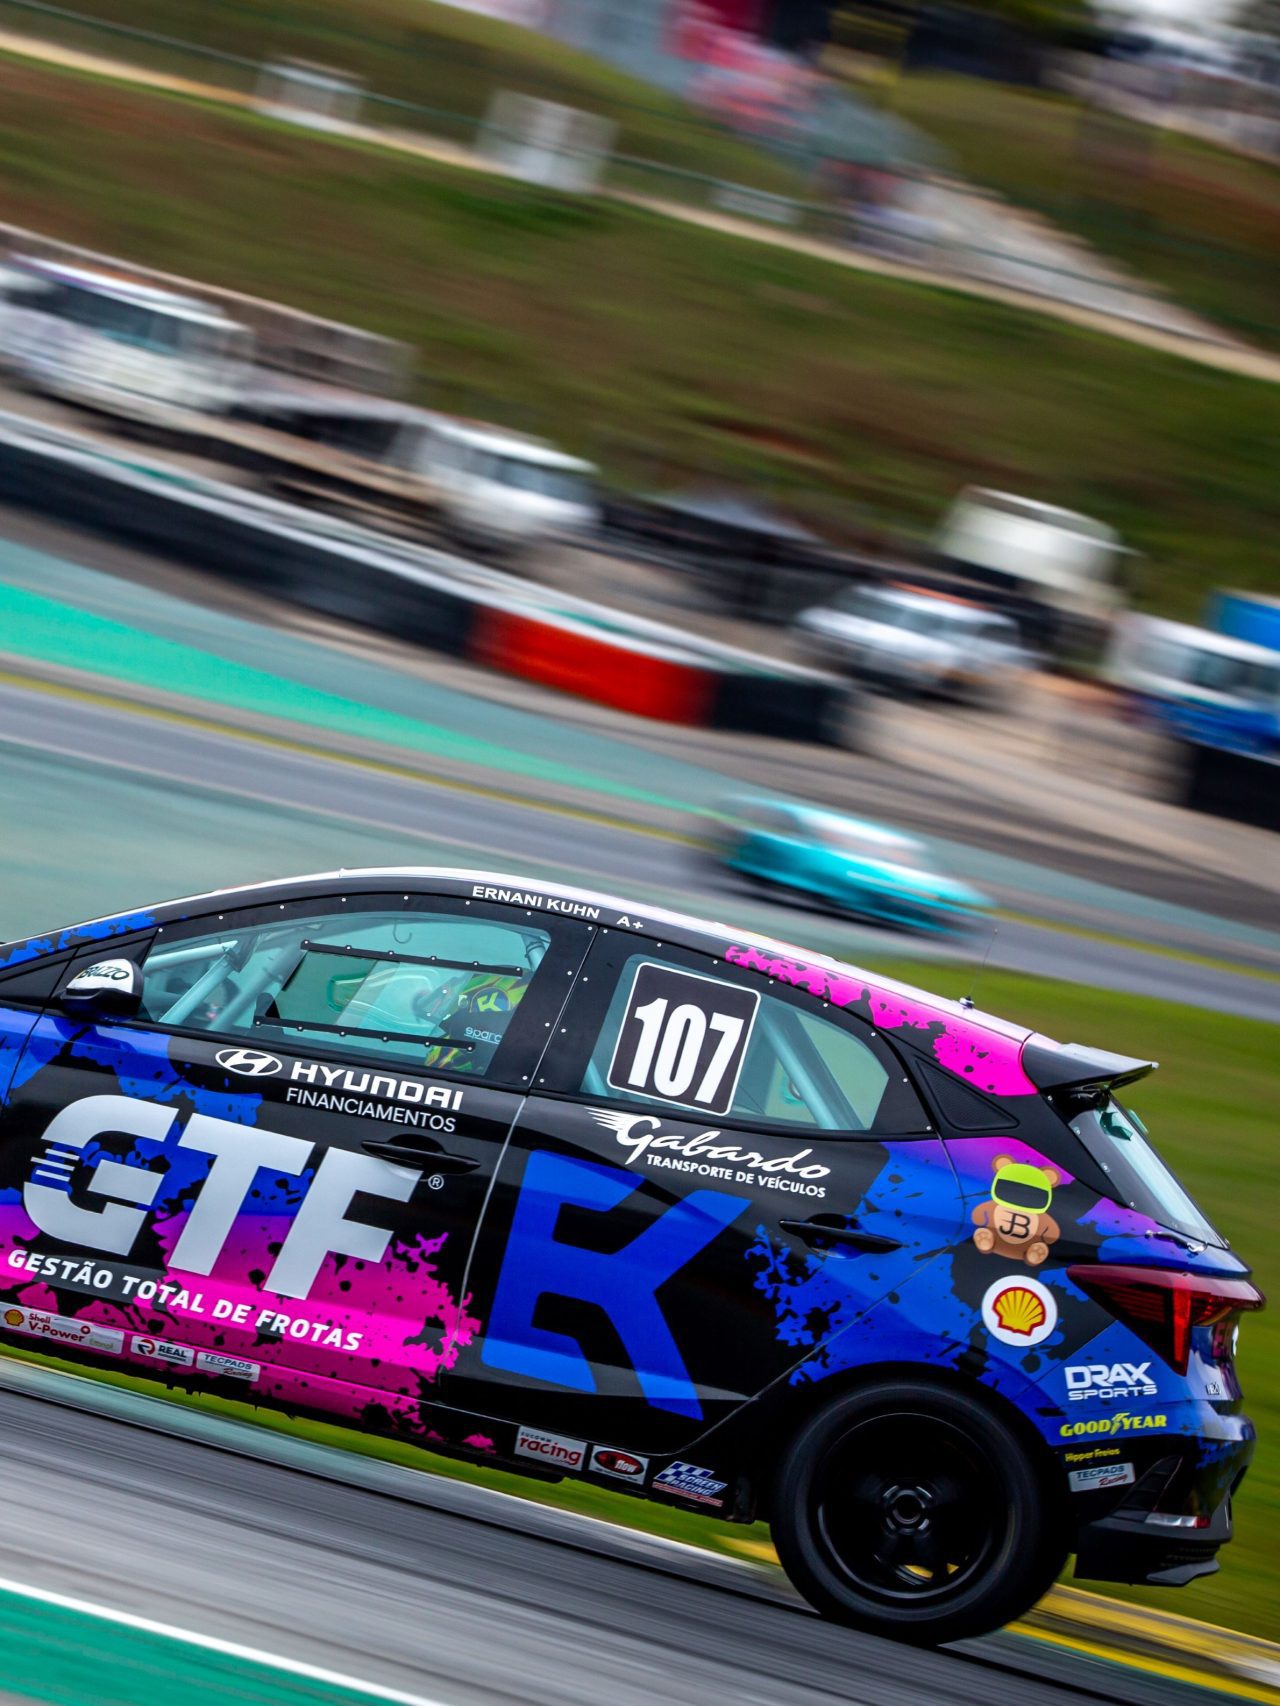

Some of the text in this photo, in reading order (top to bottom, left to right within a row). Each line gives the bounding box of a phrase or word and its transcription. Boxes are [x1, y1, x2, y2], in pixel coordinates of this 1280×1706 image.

[472, 885, 644, 929] ERNANI KUHN A+
[464, 1026, 502, 1043] sparc
[627, 997, 745, 1104] 107
[289, 1060, 464, 1111] HYUNDAI
[286, 1087, 456, 1133] FINANCIAMENTOS
[614, 1115, 831, 1180] Gabardo
[646, 1154, 827, 1199] TRANSPORTE DE VEÍCULOS
[22, 1095, 424, 1300] GTF
[7, 1249, 363, 1351] GESTÃO TOTAL DE FROTAS
[29, 1313, 52, 1324] Shell
[29, 1321, 86, 1343] V-Power
[157, 1344, 188, 1358] REAL
[205, 1354, 252, 1370] TECPADS
[1064, 1362, 1156, 1390] DRAX
[1068, 1384, 1158, 1401] SPORTS
[1060, 1412, 1167, 1437] GOODYEAR
[519, 1437, 582, 1465] racing
[679, 1474, 723, 1490] SCREEN
[1076, 1465, 1125, 1479] TECPADS
[670, 1480, 713, 1497] RACING
